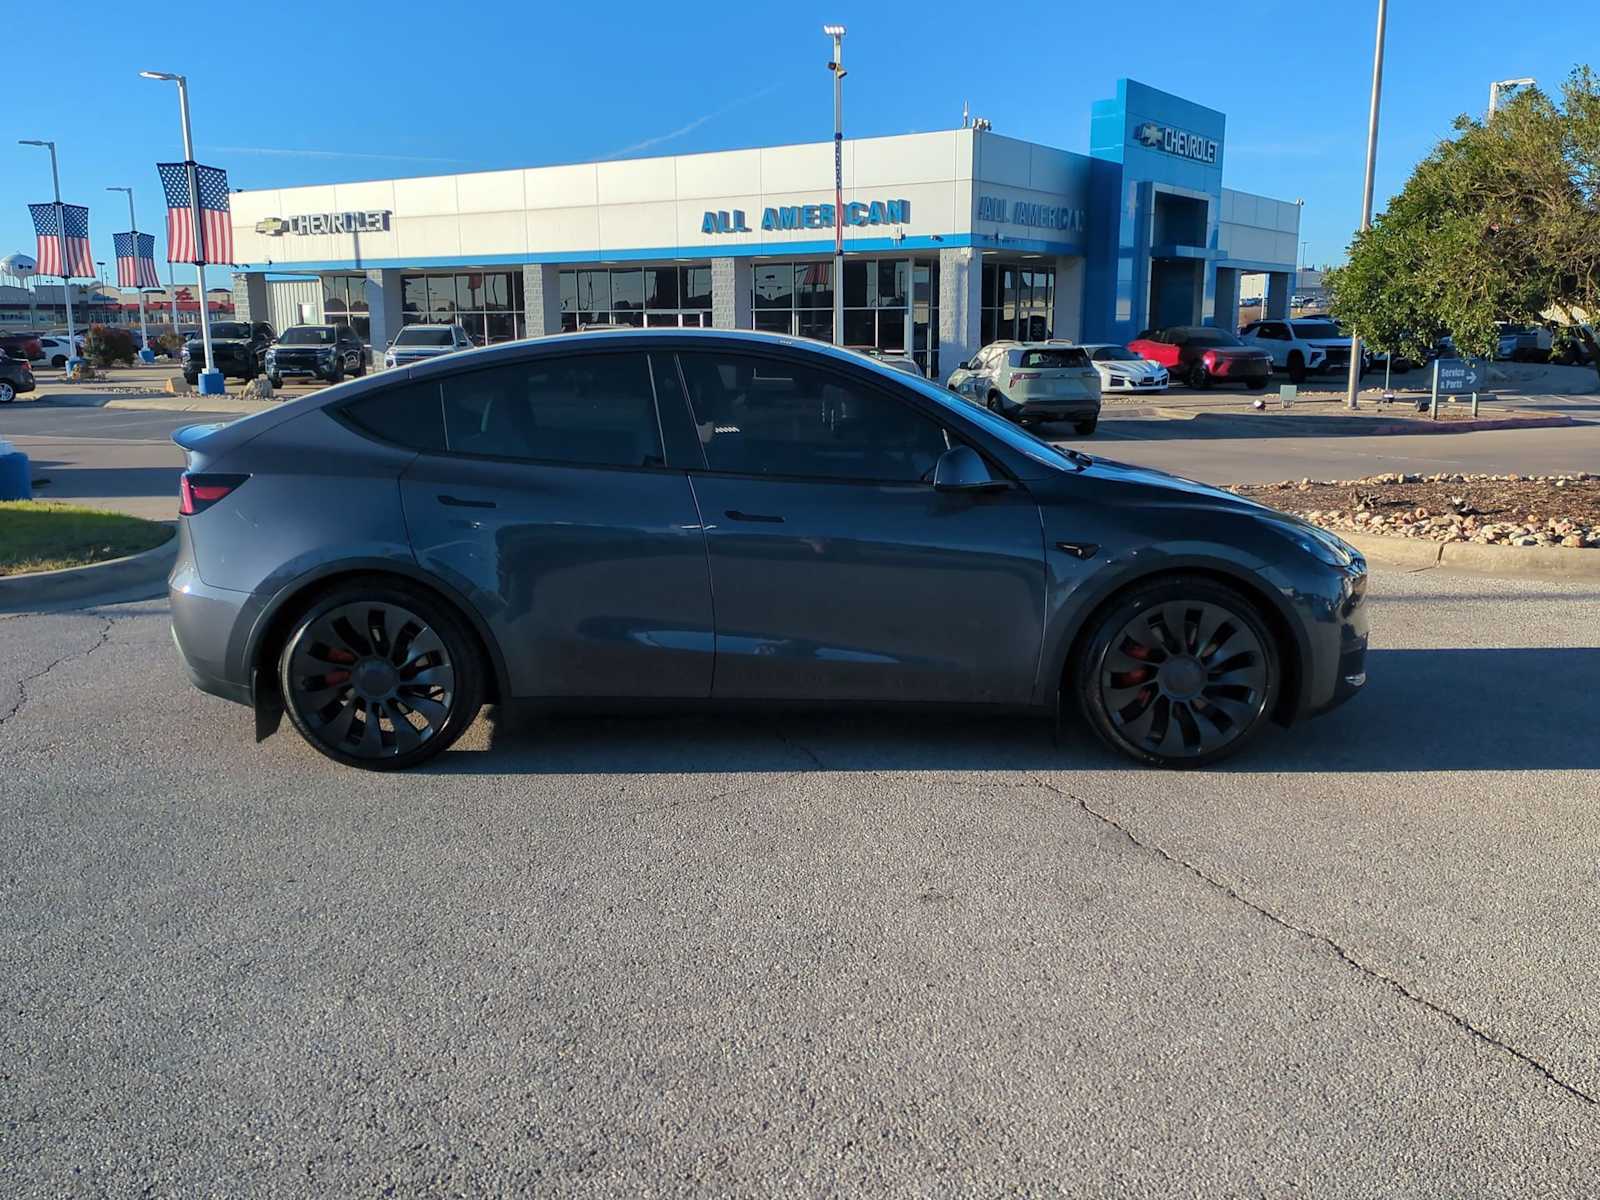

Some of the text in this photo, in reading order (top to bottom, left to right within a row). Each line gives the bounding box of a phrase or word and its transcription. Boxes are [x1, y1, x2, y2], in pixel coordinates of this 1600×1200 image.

[1164, 127, 1218, 163] CHEVROLET
[287, 210, 391, 235] CHEVROLET
[702, 199, 910, 233] ALL AMERCAN
[981, 197, 1010, 223] ALL
